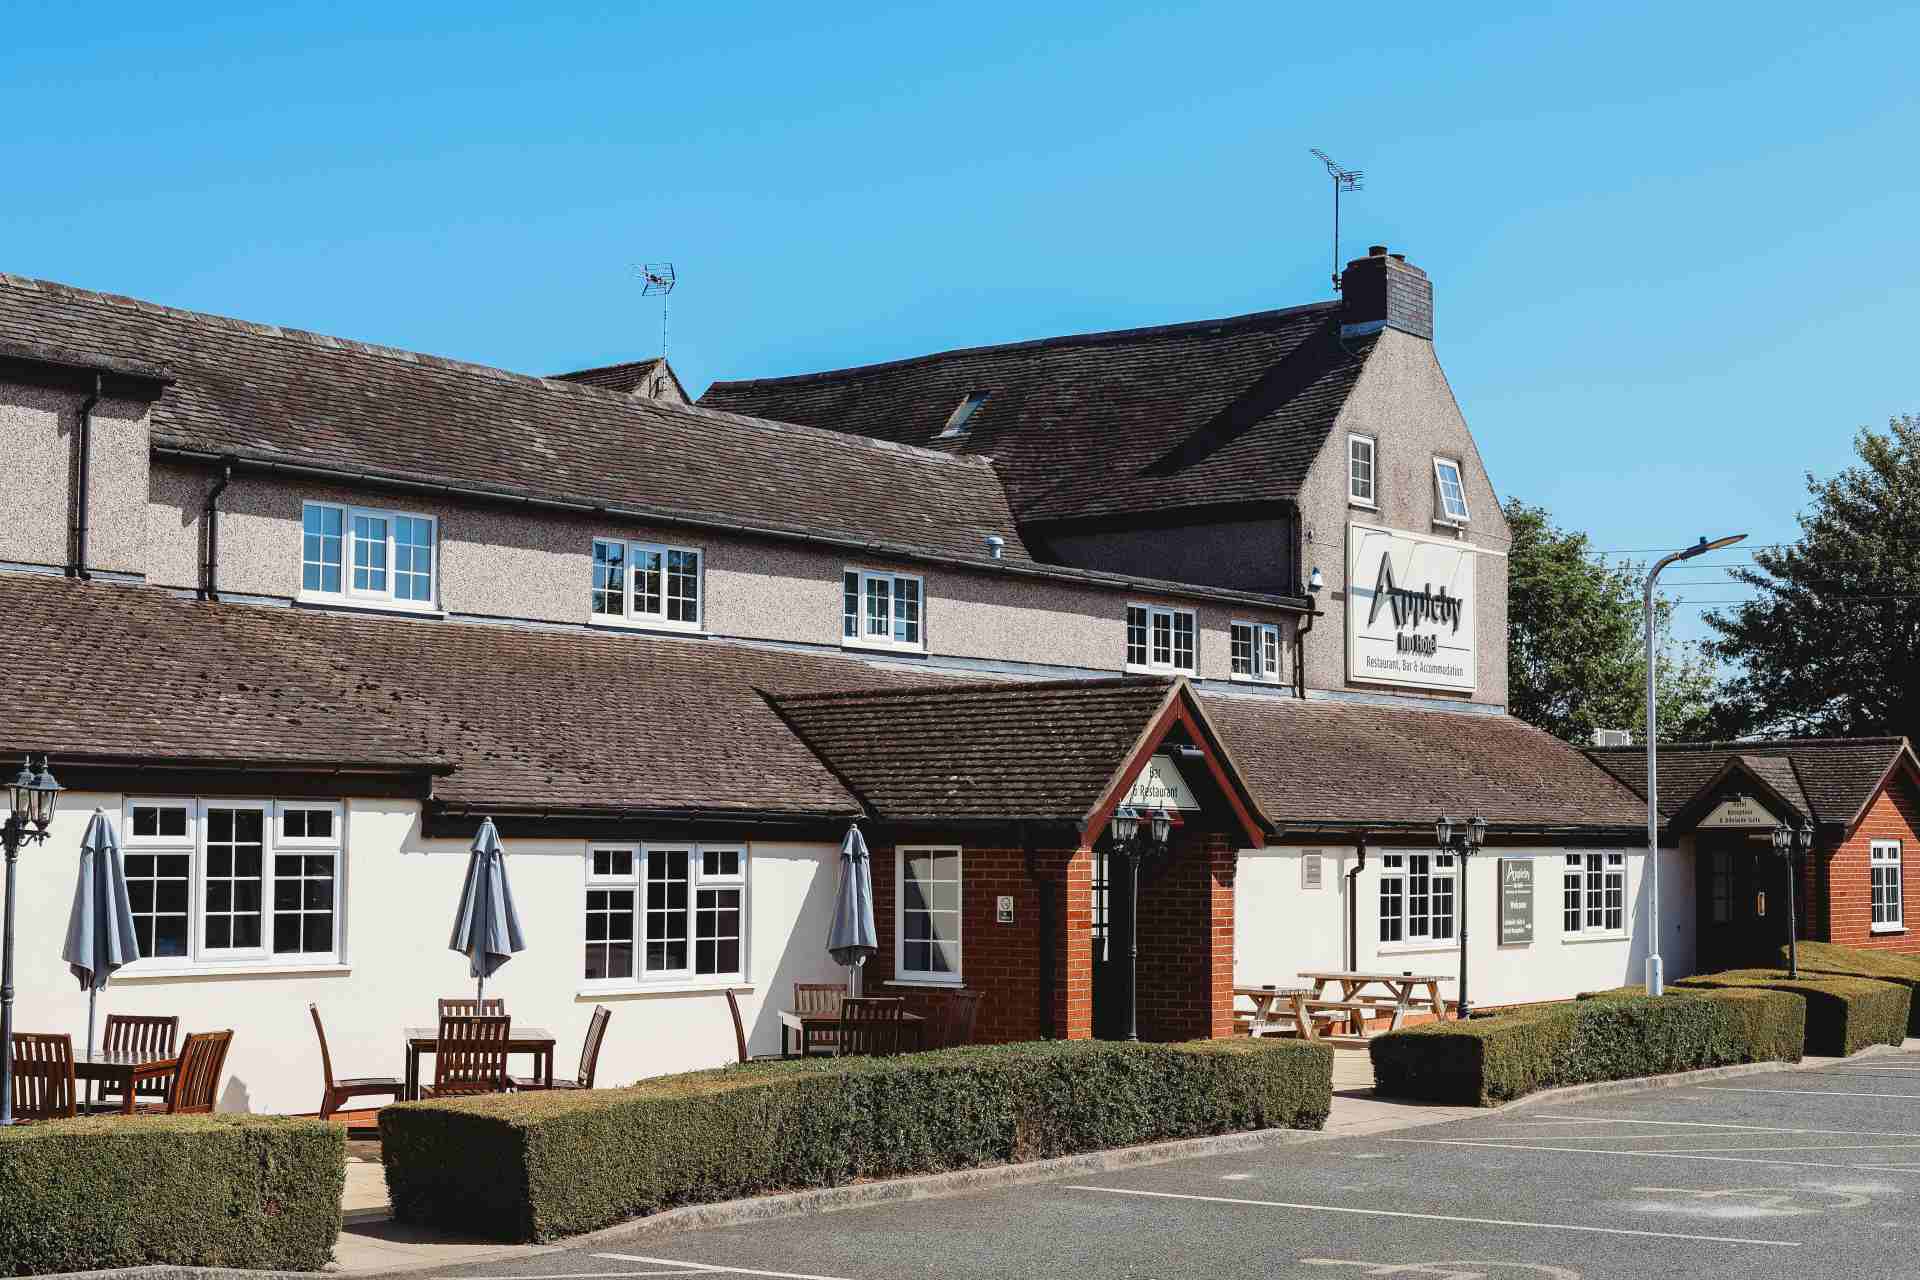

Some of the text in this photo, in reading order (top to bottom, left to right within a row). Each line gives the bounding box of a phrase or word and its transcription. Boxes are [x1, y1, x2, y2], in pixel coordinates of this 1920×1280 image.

[1367, 551, 1464, 637] Appleby
[1366, 655, 1400, 673] Restaurant,
[1402, 659, 1412, 672] Bar
[1140, 784, 1178, 798] Restaurant
